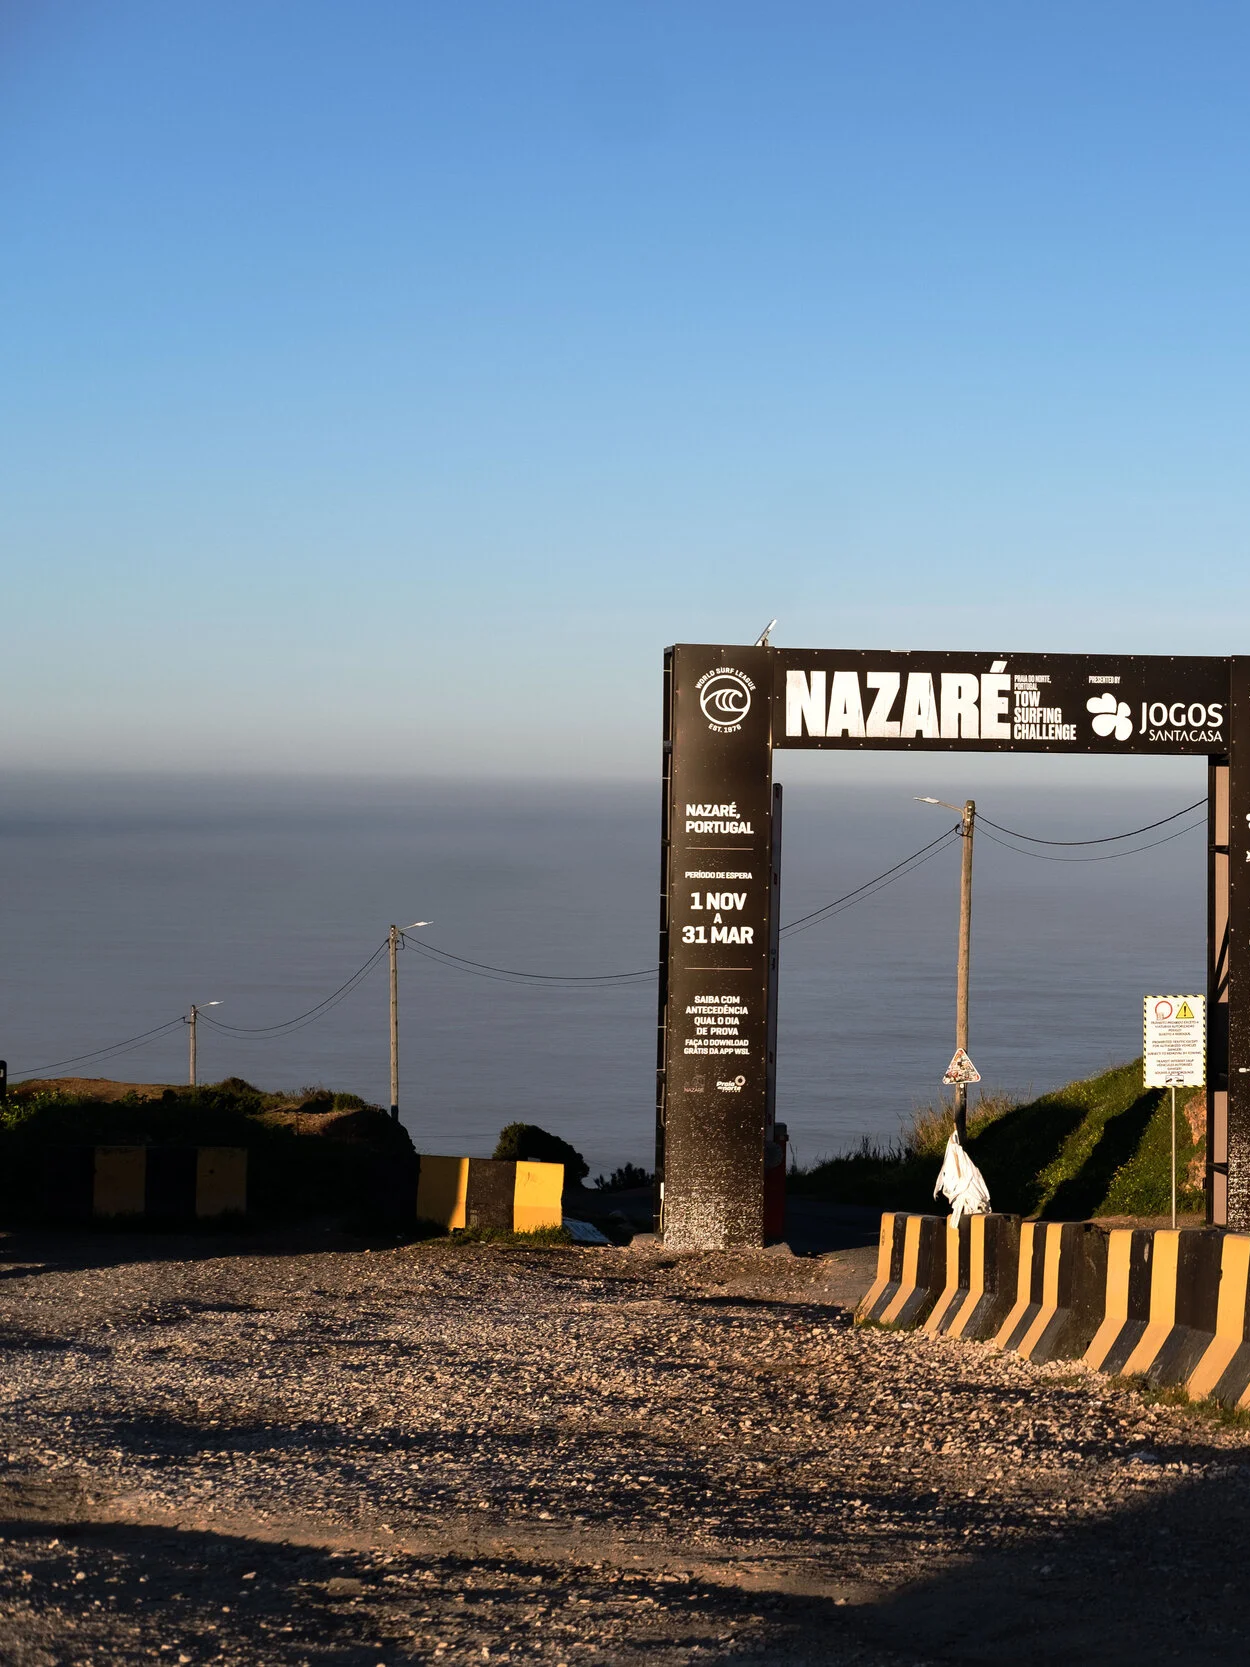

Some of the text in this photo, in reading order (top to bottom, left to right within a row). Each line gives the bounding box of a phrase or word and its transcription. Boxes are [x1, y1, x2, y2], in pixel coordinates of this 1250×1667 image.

[695, 670, 715, 689] WORLD
[735, 670, 756, 691] LEAGUE
[1114, 676, 1120, 684] BY
[786, 660, 1011, 740] NAZARÉ
[1014, 691, 1040, 707] TOW
[1014, 707, 1062, 724] SURFING
[1139, 702, 1223, 734] JOGOS
[708, 723, 722, 733] EST.
[1014, 724, 1076, 740] CHALLENGE
[686, 802, 740, 819] NAZARÉ,
[686, 820, 754, 834] PORTUGAL
[685, 870, 715, 879] PERÍODO
[690, 892, 747, 910] 1 NOV
[713, 913, 722, 924] A
[682, 926, 754, 944] 31 MAR
[694, 995, 740, 1004] SAIBA COM
[686, 1005, 748, 1014] ANTECEDÊNCIA
[694, 1017, 716, 1026] QUAL
[684, 1046, 708, 1054] GRÁTIS
[685, 1039, 702, 1047] FAÇA
